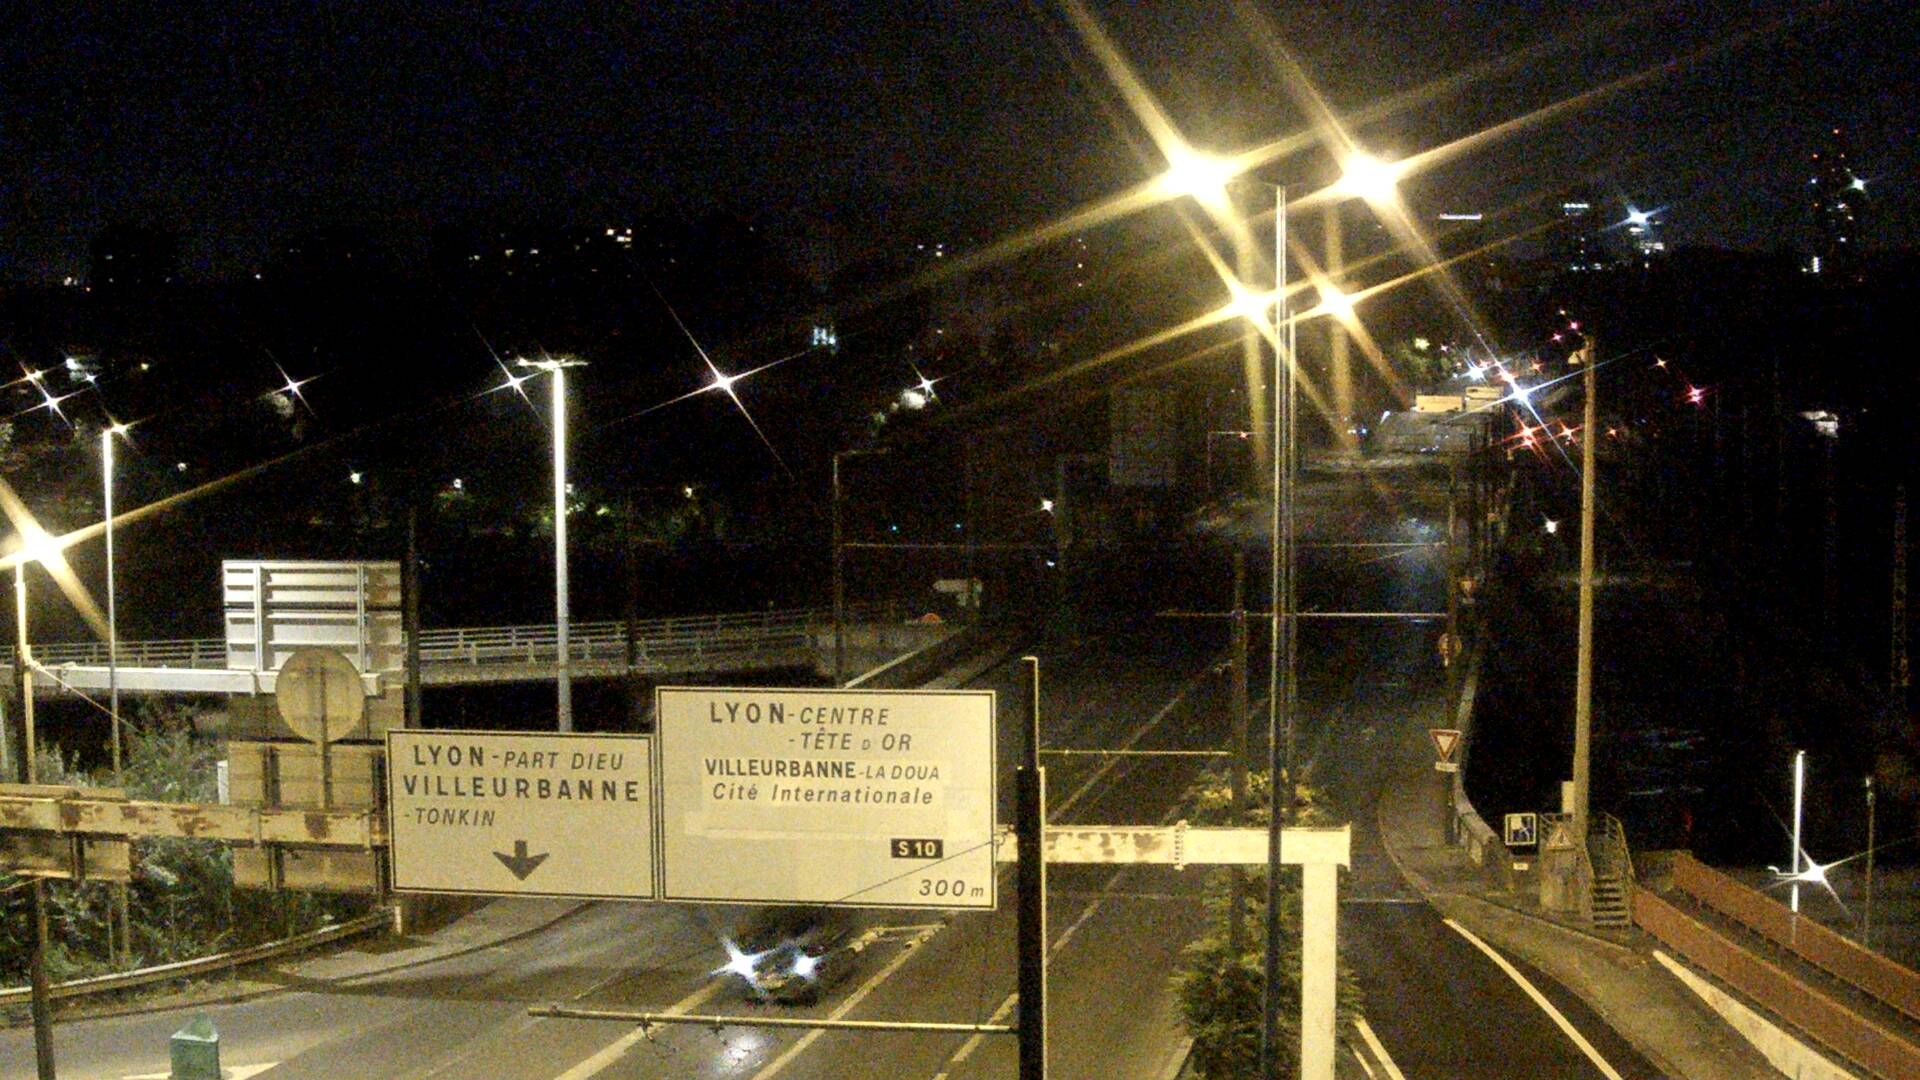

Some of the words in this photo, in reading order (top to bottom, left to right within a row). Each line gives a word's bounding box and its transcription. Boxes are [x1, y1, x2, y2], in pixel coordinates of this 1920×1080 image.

[881, 733, 913, 751] OR
[571, 752, 624, 770] DIEU
[891, 764, 940, 781] DOUA
[403, 775, 639, 802] VILLEURBANNE
[713, 781, 758, 801] Cité
[771, 784, 933, 805] Internationale
